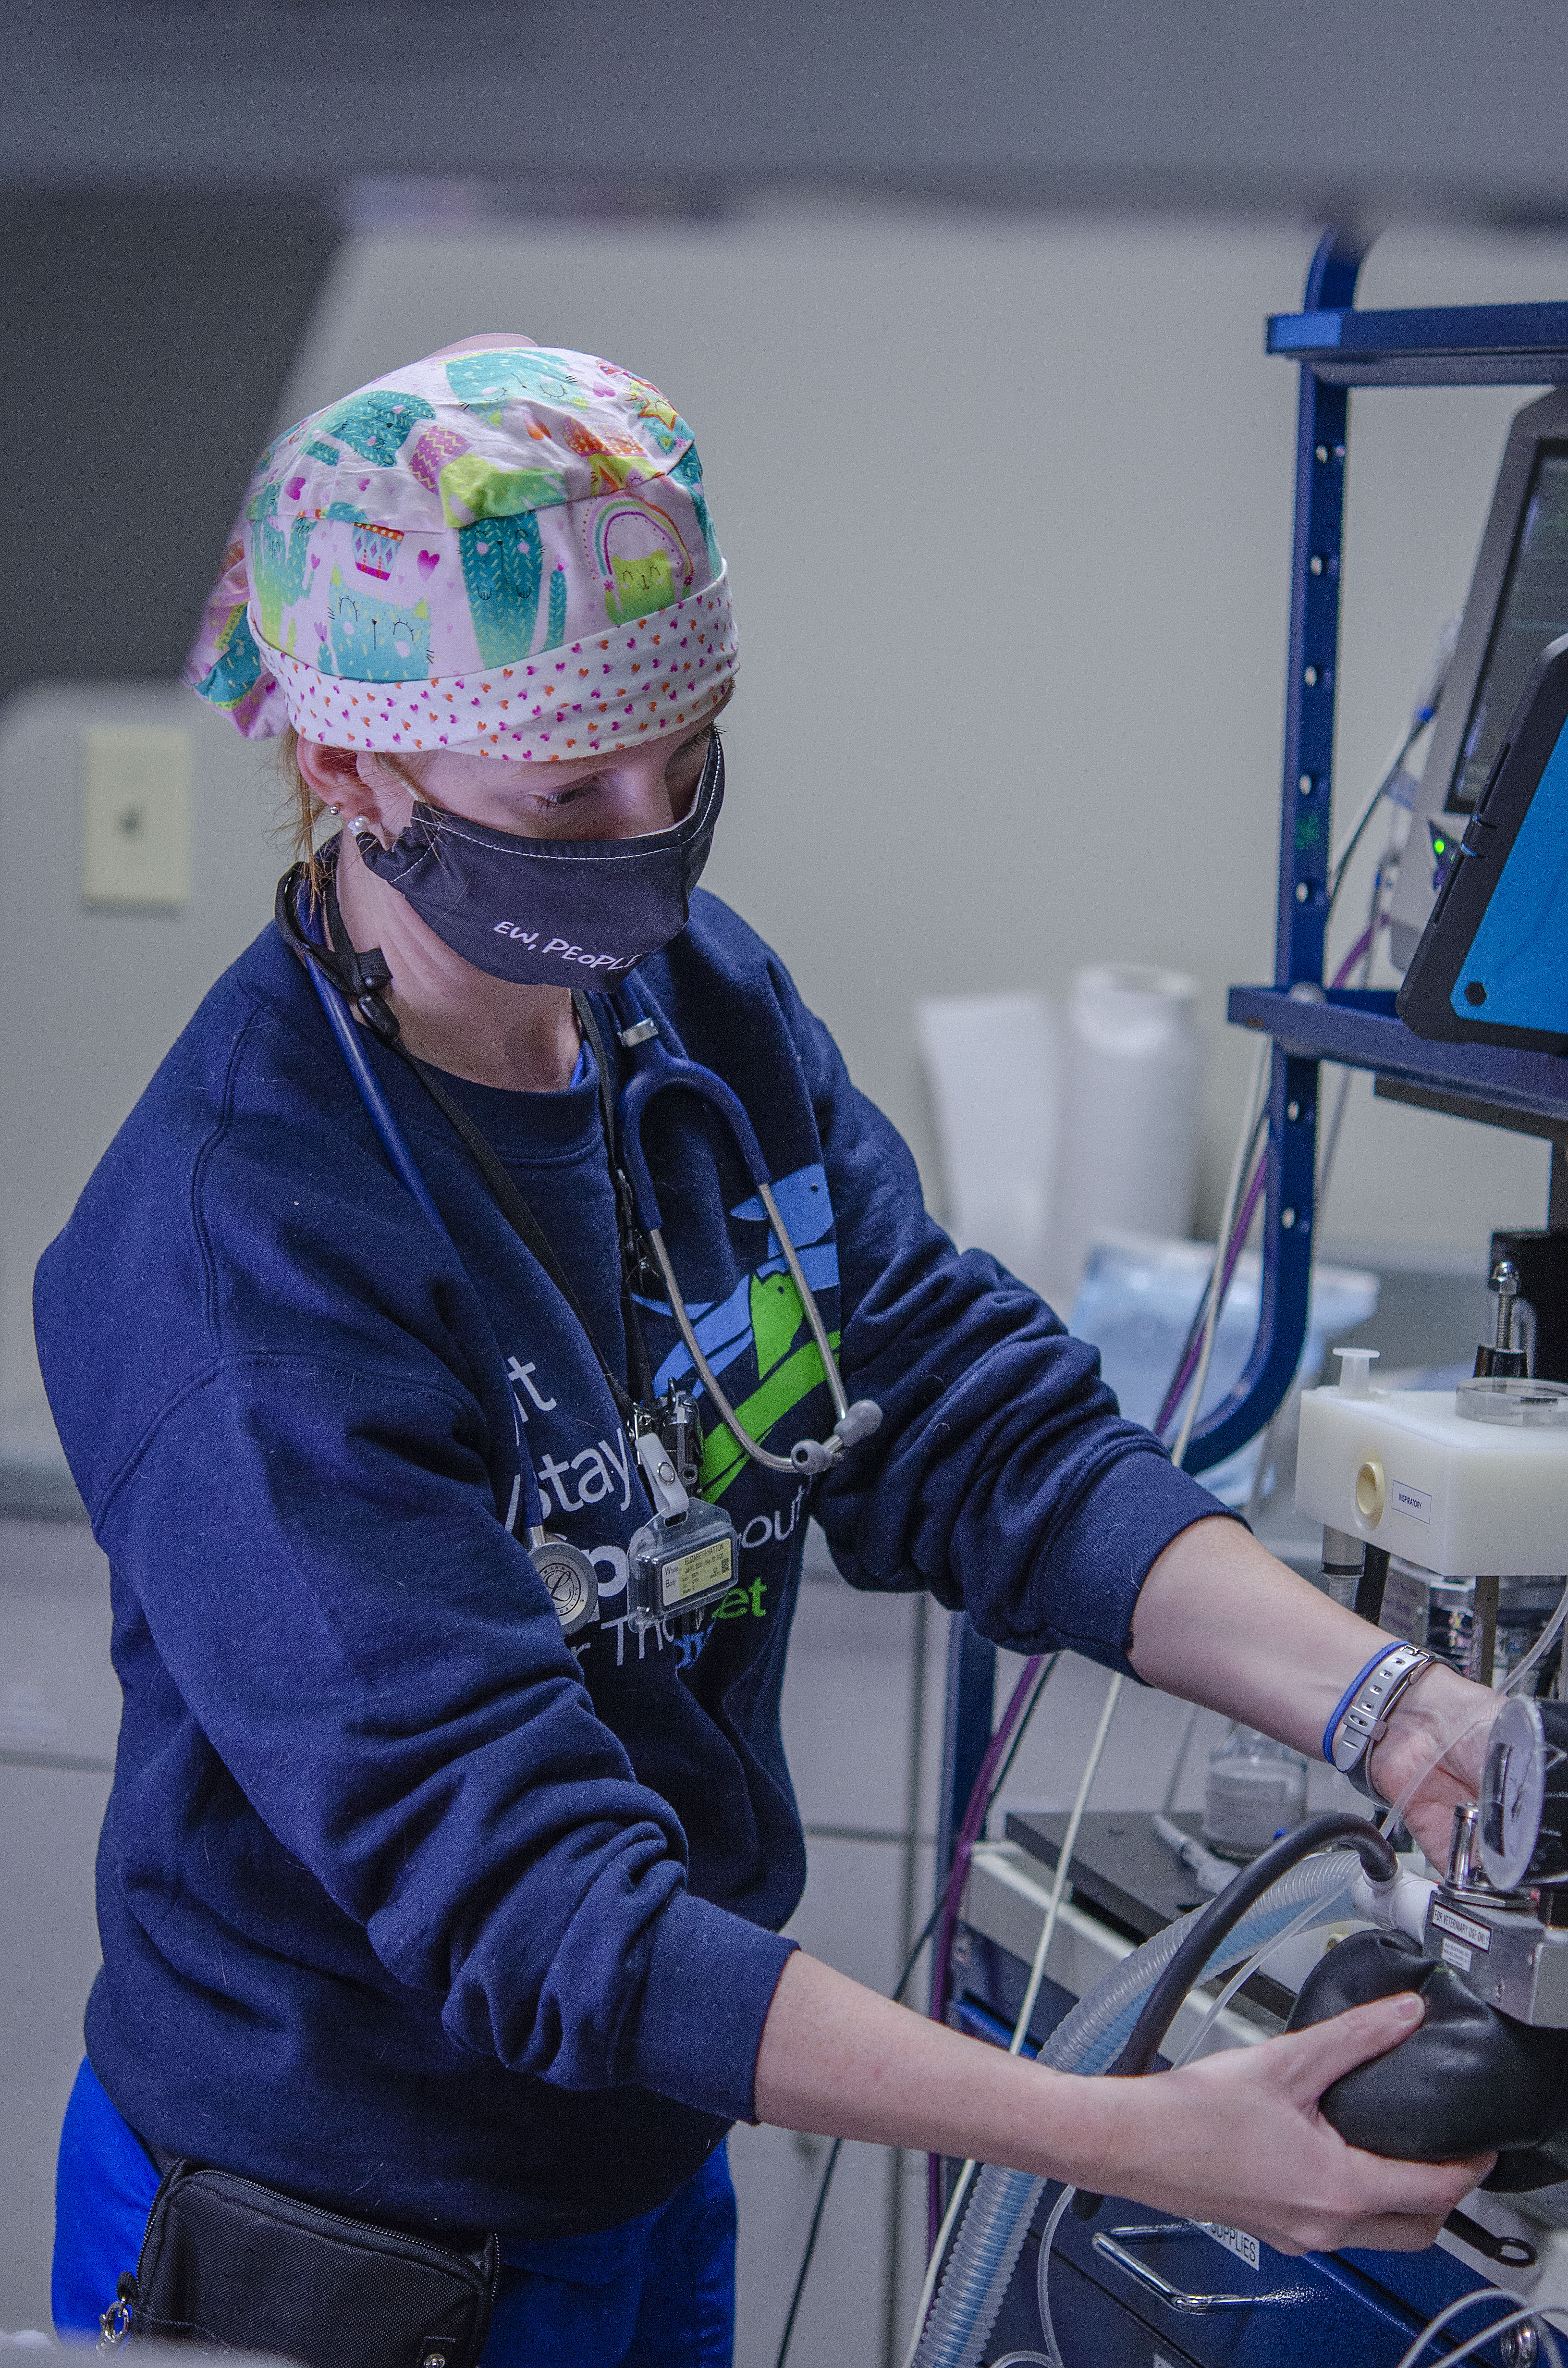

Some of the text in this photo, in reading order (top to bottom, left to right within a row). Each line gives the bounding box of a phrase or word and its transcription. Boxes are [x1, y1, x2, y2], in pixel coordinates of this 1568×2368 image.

[493, 921, 539, 951] EW,
[1398, 1493, 1422, 1509] INSPIRATORY
[559, 1587, 579, 1614] UALITY
[1434, 1910, 1490, 1945] FOR VETERINARY USE ONLY
